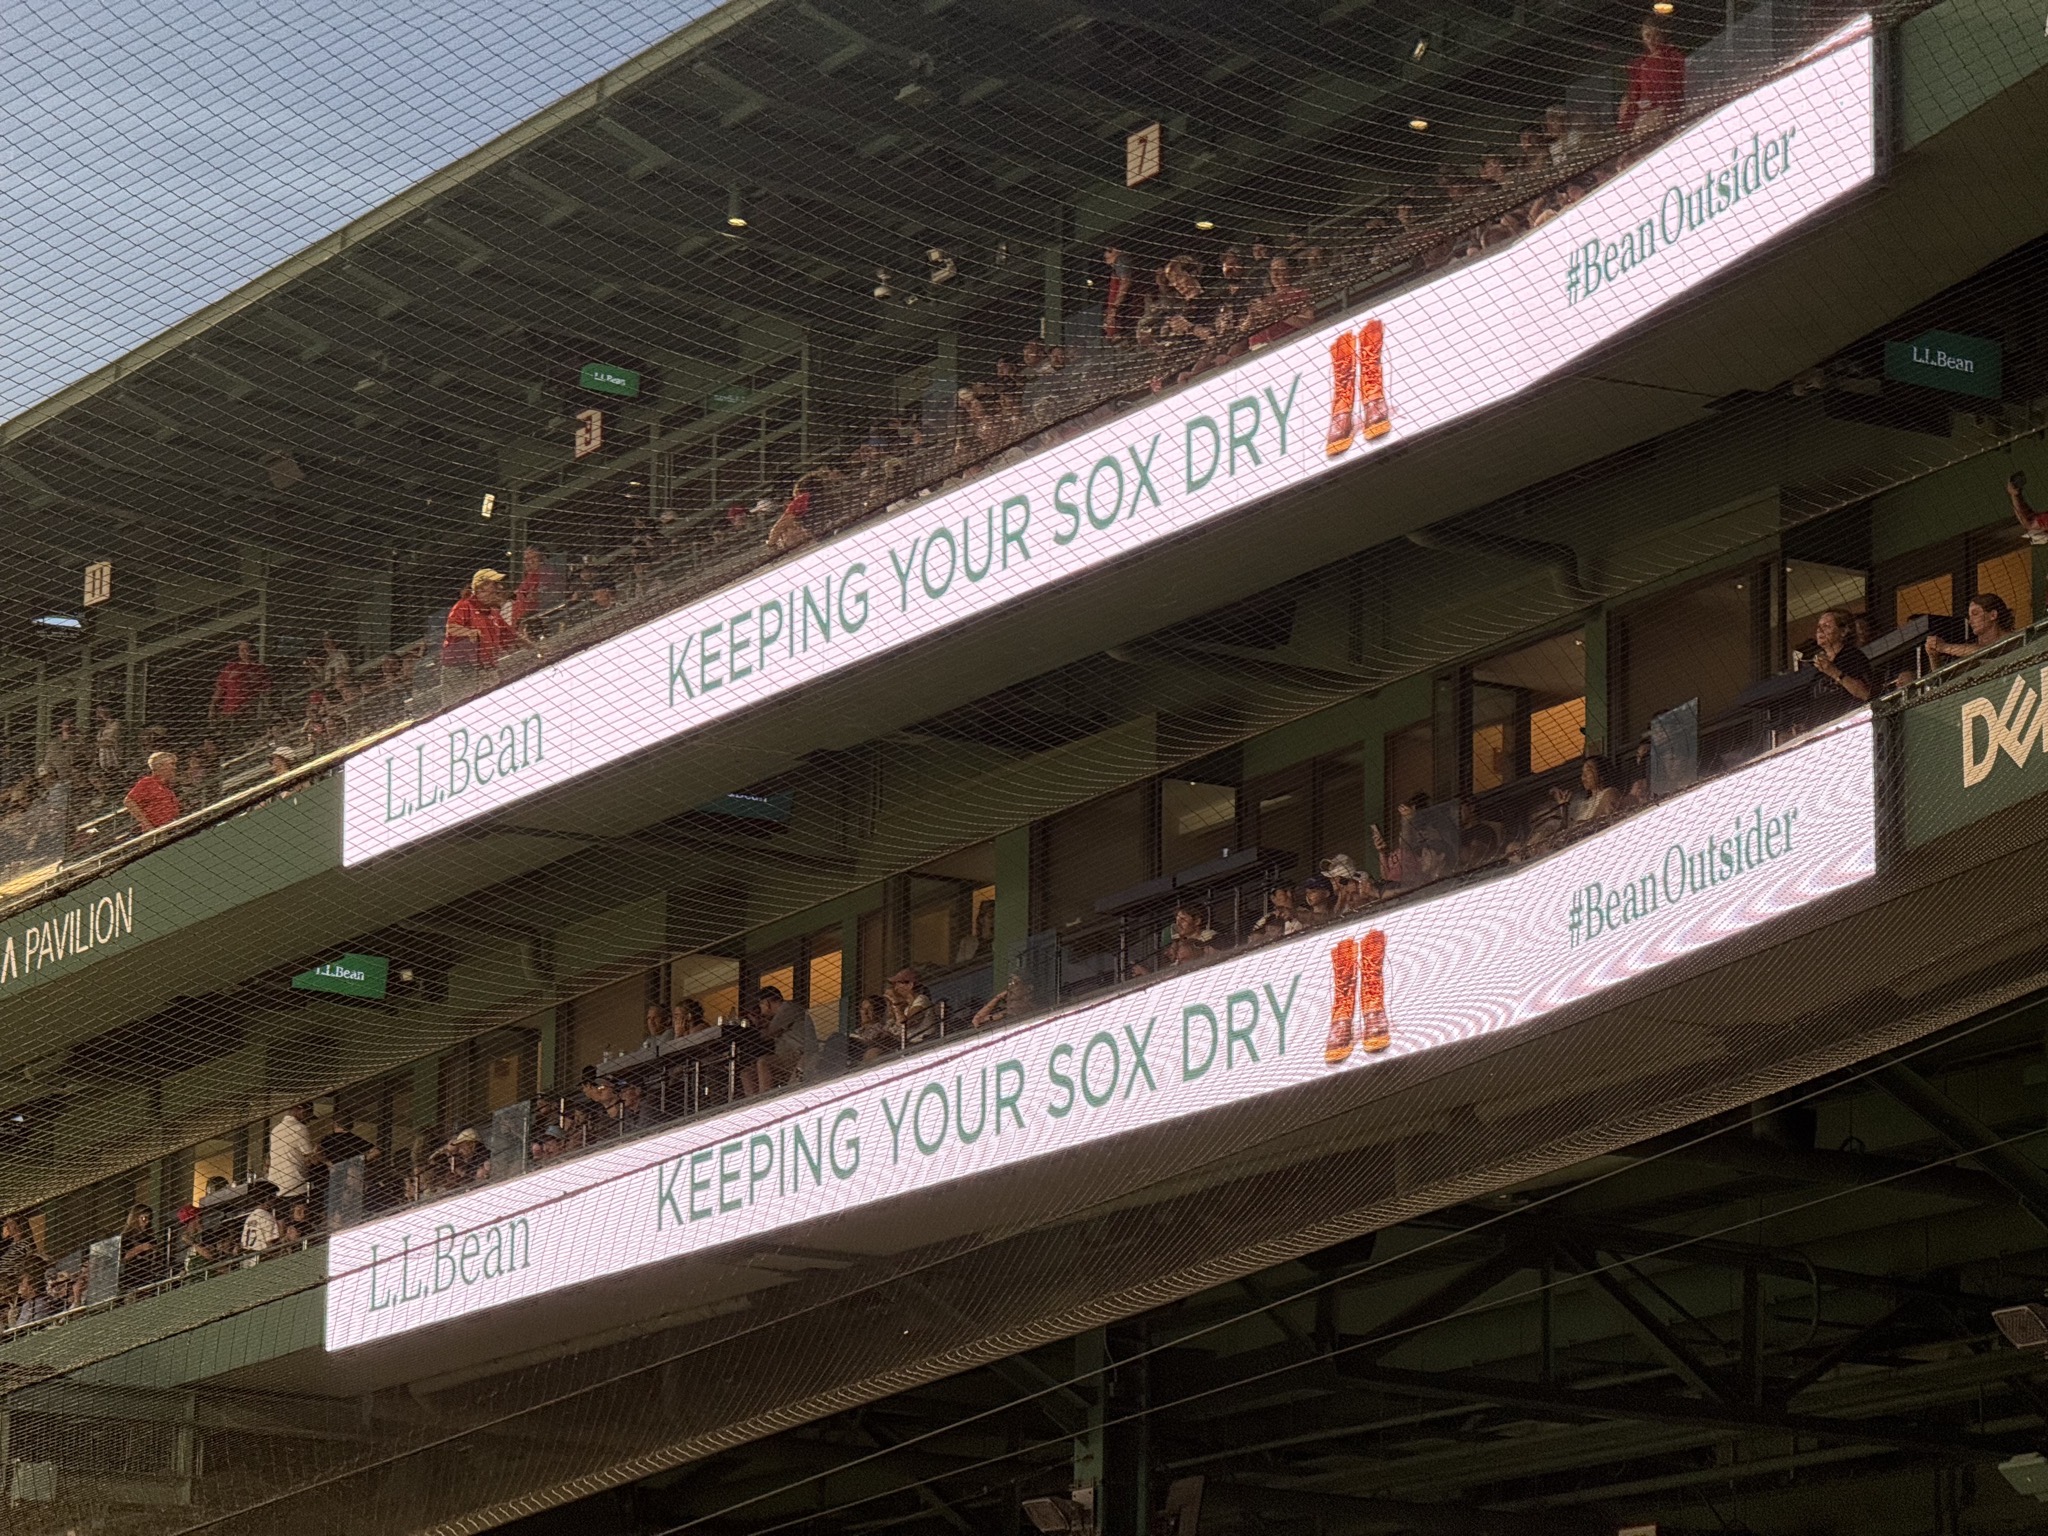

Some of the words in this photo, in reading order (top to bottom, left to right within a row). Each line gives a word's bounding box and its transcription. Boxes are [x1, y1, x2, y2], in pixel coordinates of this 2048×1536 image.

[1138, 135, 1149, 176] 7
[1567, 125, 1797, 307] #BeanOutsider
[1911, 345, 1975, 373] L.L.Bean
[670, 563, 871, 706] KEEPING
[889, 495, 1031, 612] YOUR
[1054, 434, 1160, 546] SOX
[1185, 373, 1303, 494] DRY
[384, 712, 546, 823] L.L.Bean
[1961, 665, 2048, 789] DE
[25, 887, 133, 974] PAVILION
[1569, 808, 1799, 948] #BeanOutsider
[657, 1108, 861, 1231] KEEPING
[882, 1060, 1025, 1164] YOUR
[1047, 1016, 1158, 1118] SOX
[1182, 974, 1302, 1083] DRY
[369, 1214, 531, 1312] L.L.Bean
